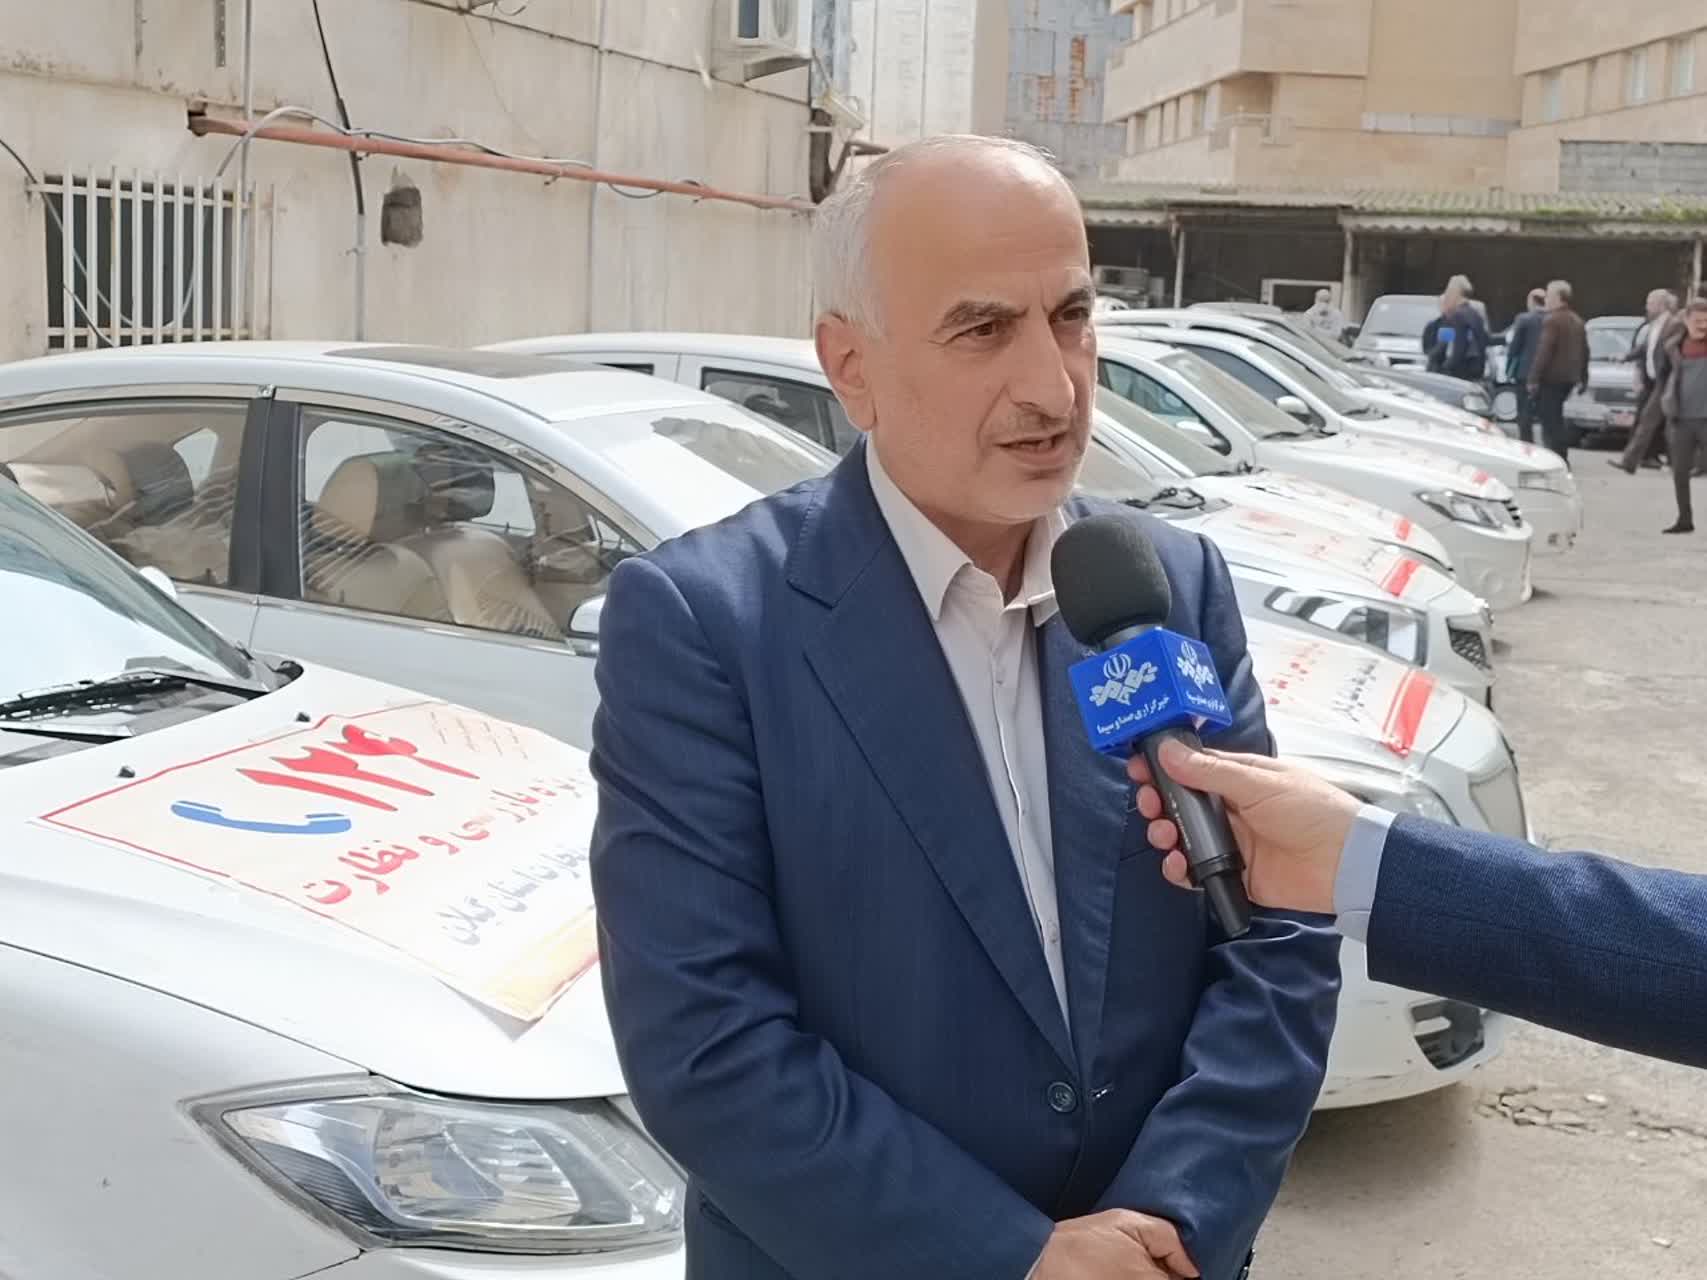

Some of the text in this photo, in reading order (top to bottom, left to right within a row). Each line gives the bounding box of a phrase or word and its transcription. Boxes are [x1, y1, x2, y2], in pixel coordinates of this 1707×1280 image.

[235, 723, 481, 812] ۱۲۴
[302, 839, 420, 905] نظارت
[417, 834, 461, 857] و
